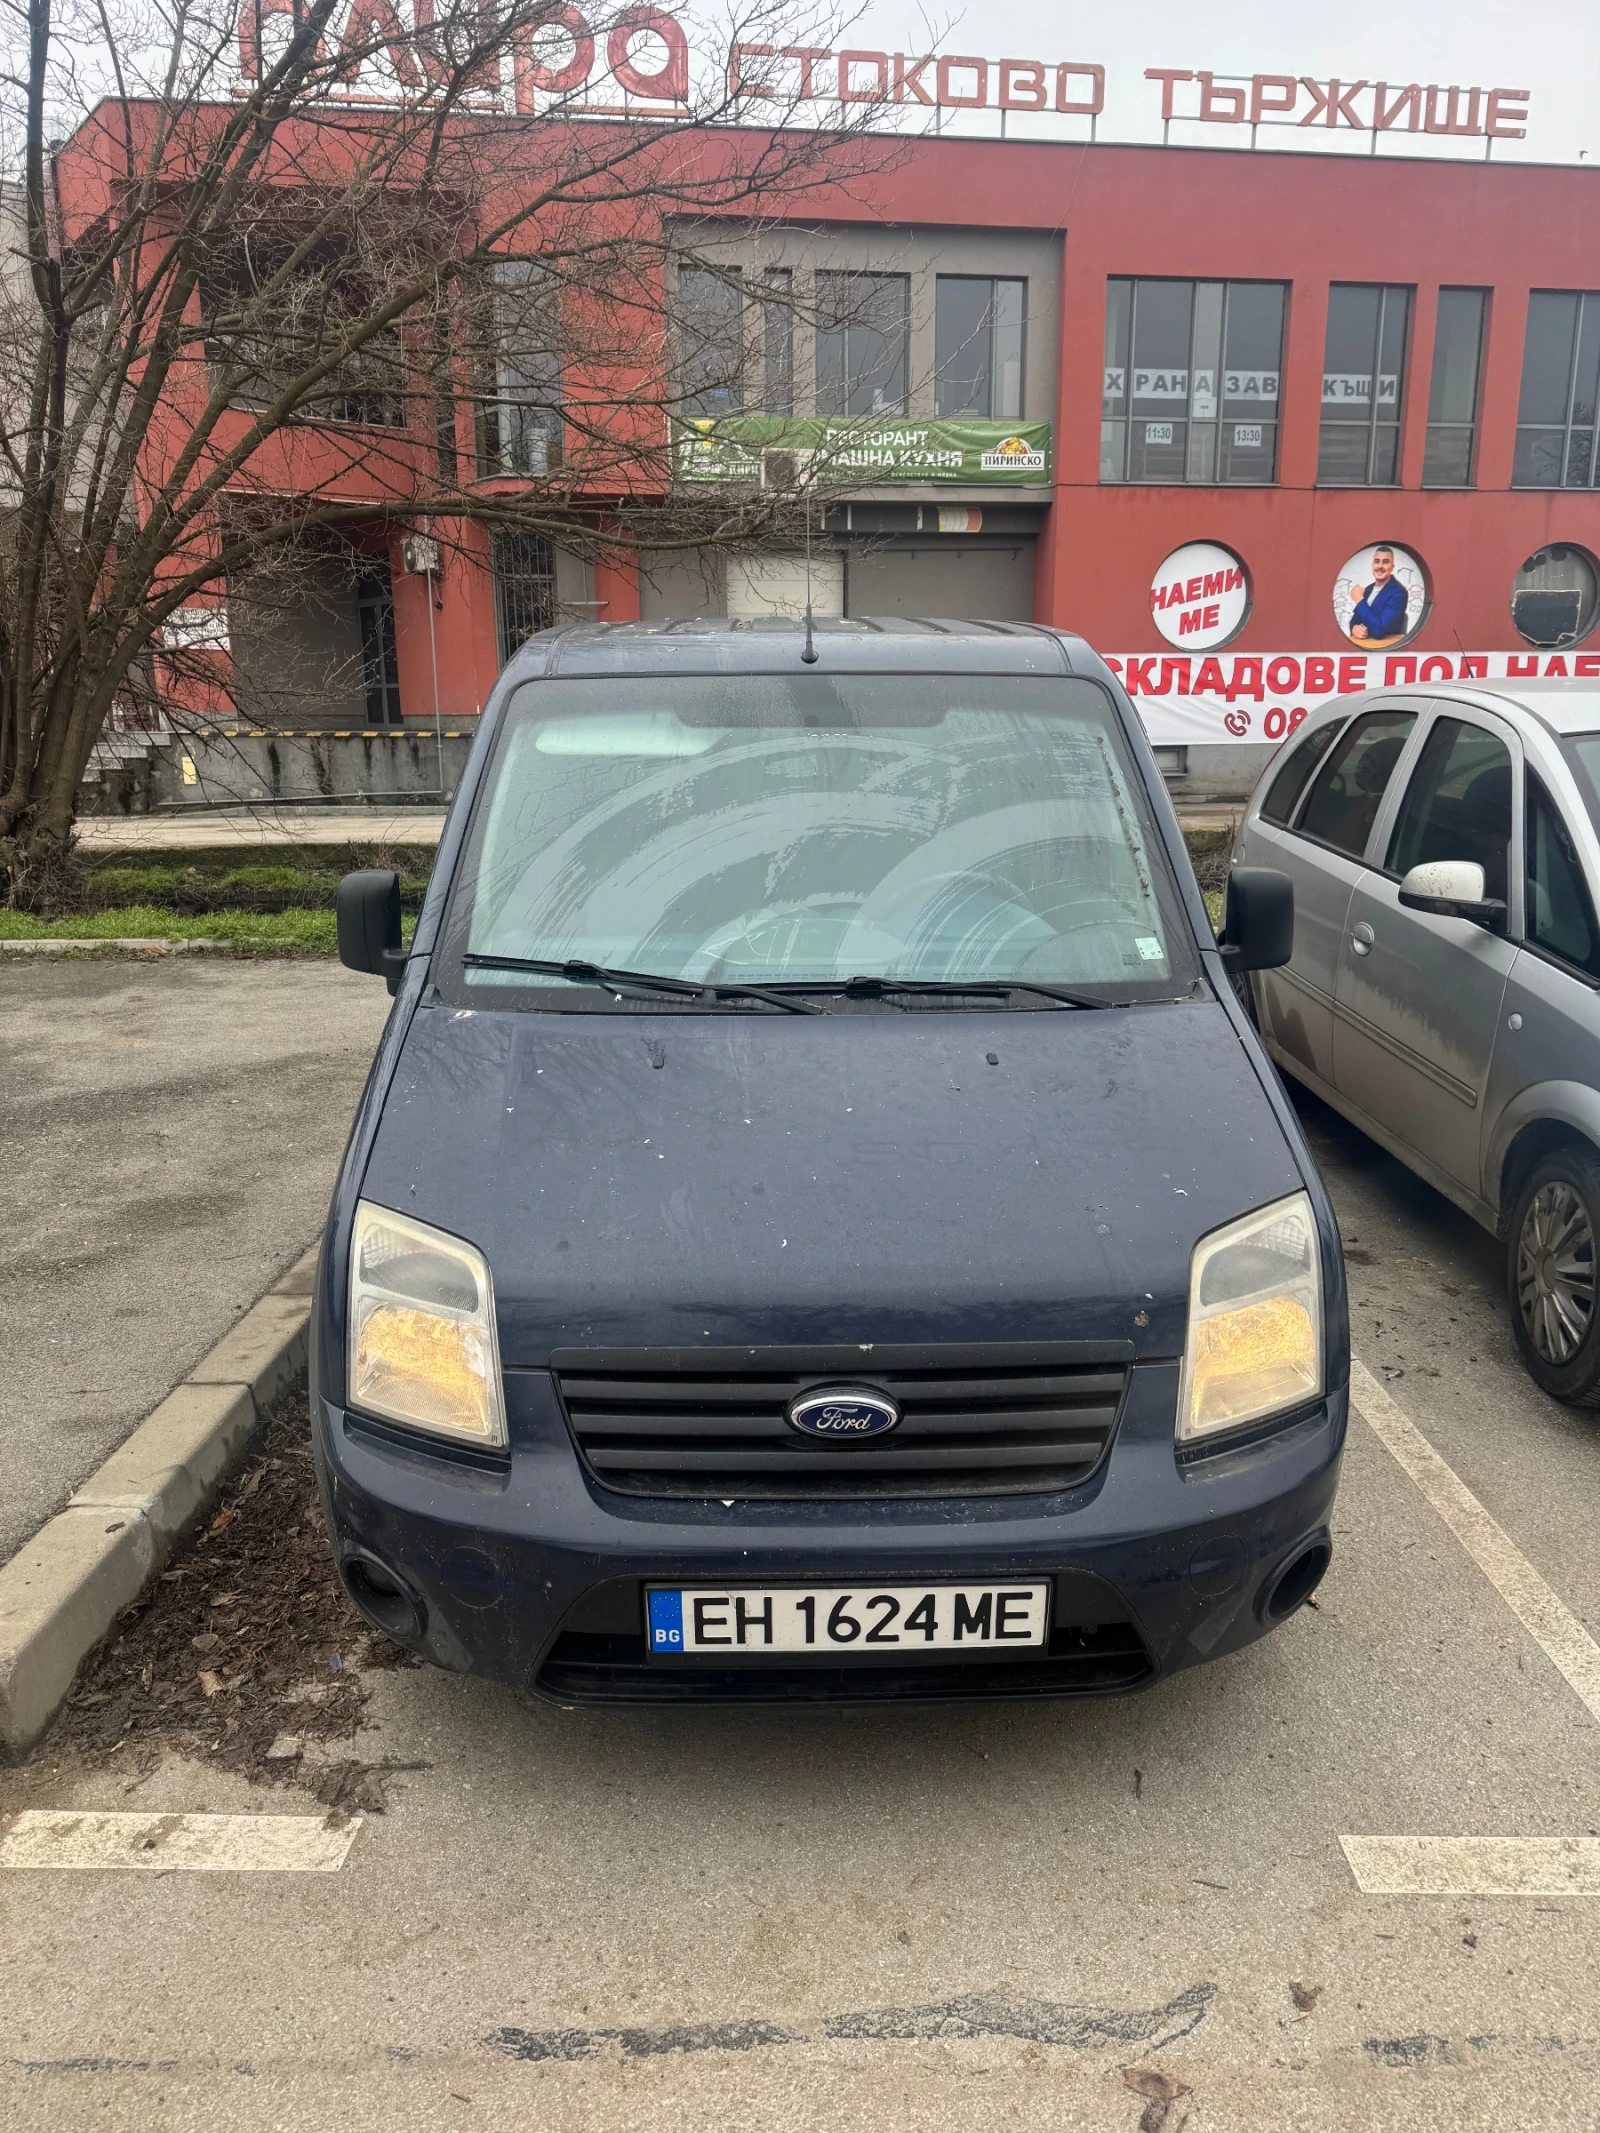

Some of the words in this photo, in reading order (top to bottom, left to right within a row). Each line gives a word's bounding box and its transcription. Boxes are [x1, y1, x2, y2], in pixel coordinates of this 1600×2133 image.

[730, 43, 1106, 114] СТОКОВО
[1146, 427, 1171, 439] 11:30
[1236, 430, 1260, 441] 13:30
[984, 455, 1042, 466] ПИРИНСКО
[1150, 566, 1244, 613] НАЕМИ
[1179, 604, 1220, 635] МЕ
[816, 1406, 873, 1430] Ford
[693, 1596, 773, 1645] EH
[796, 1594, 939, 1644] 1624
[953, 1592, 1034, 1641] ME
[655, 1629, 680, 1643] BG
